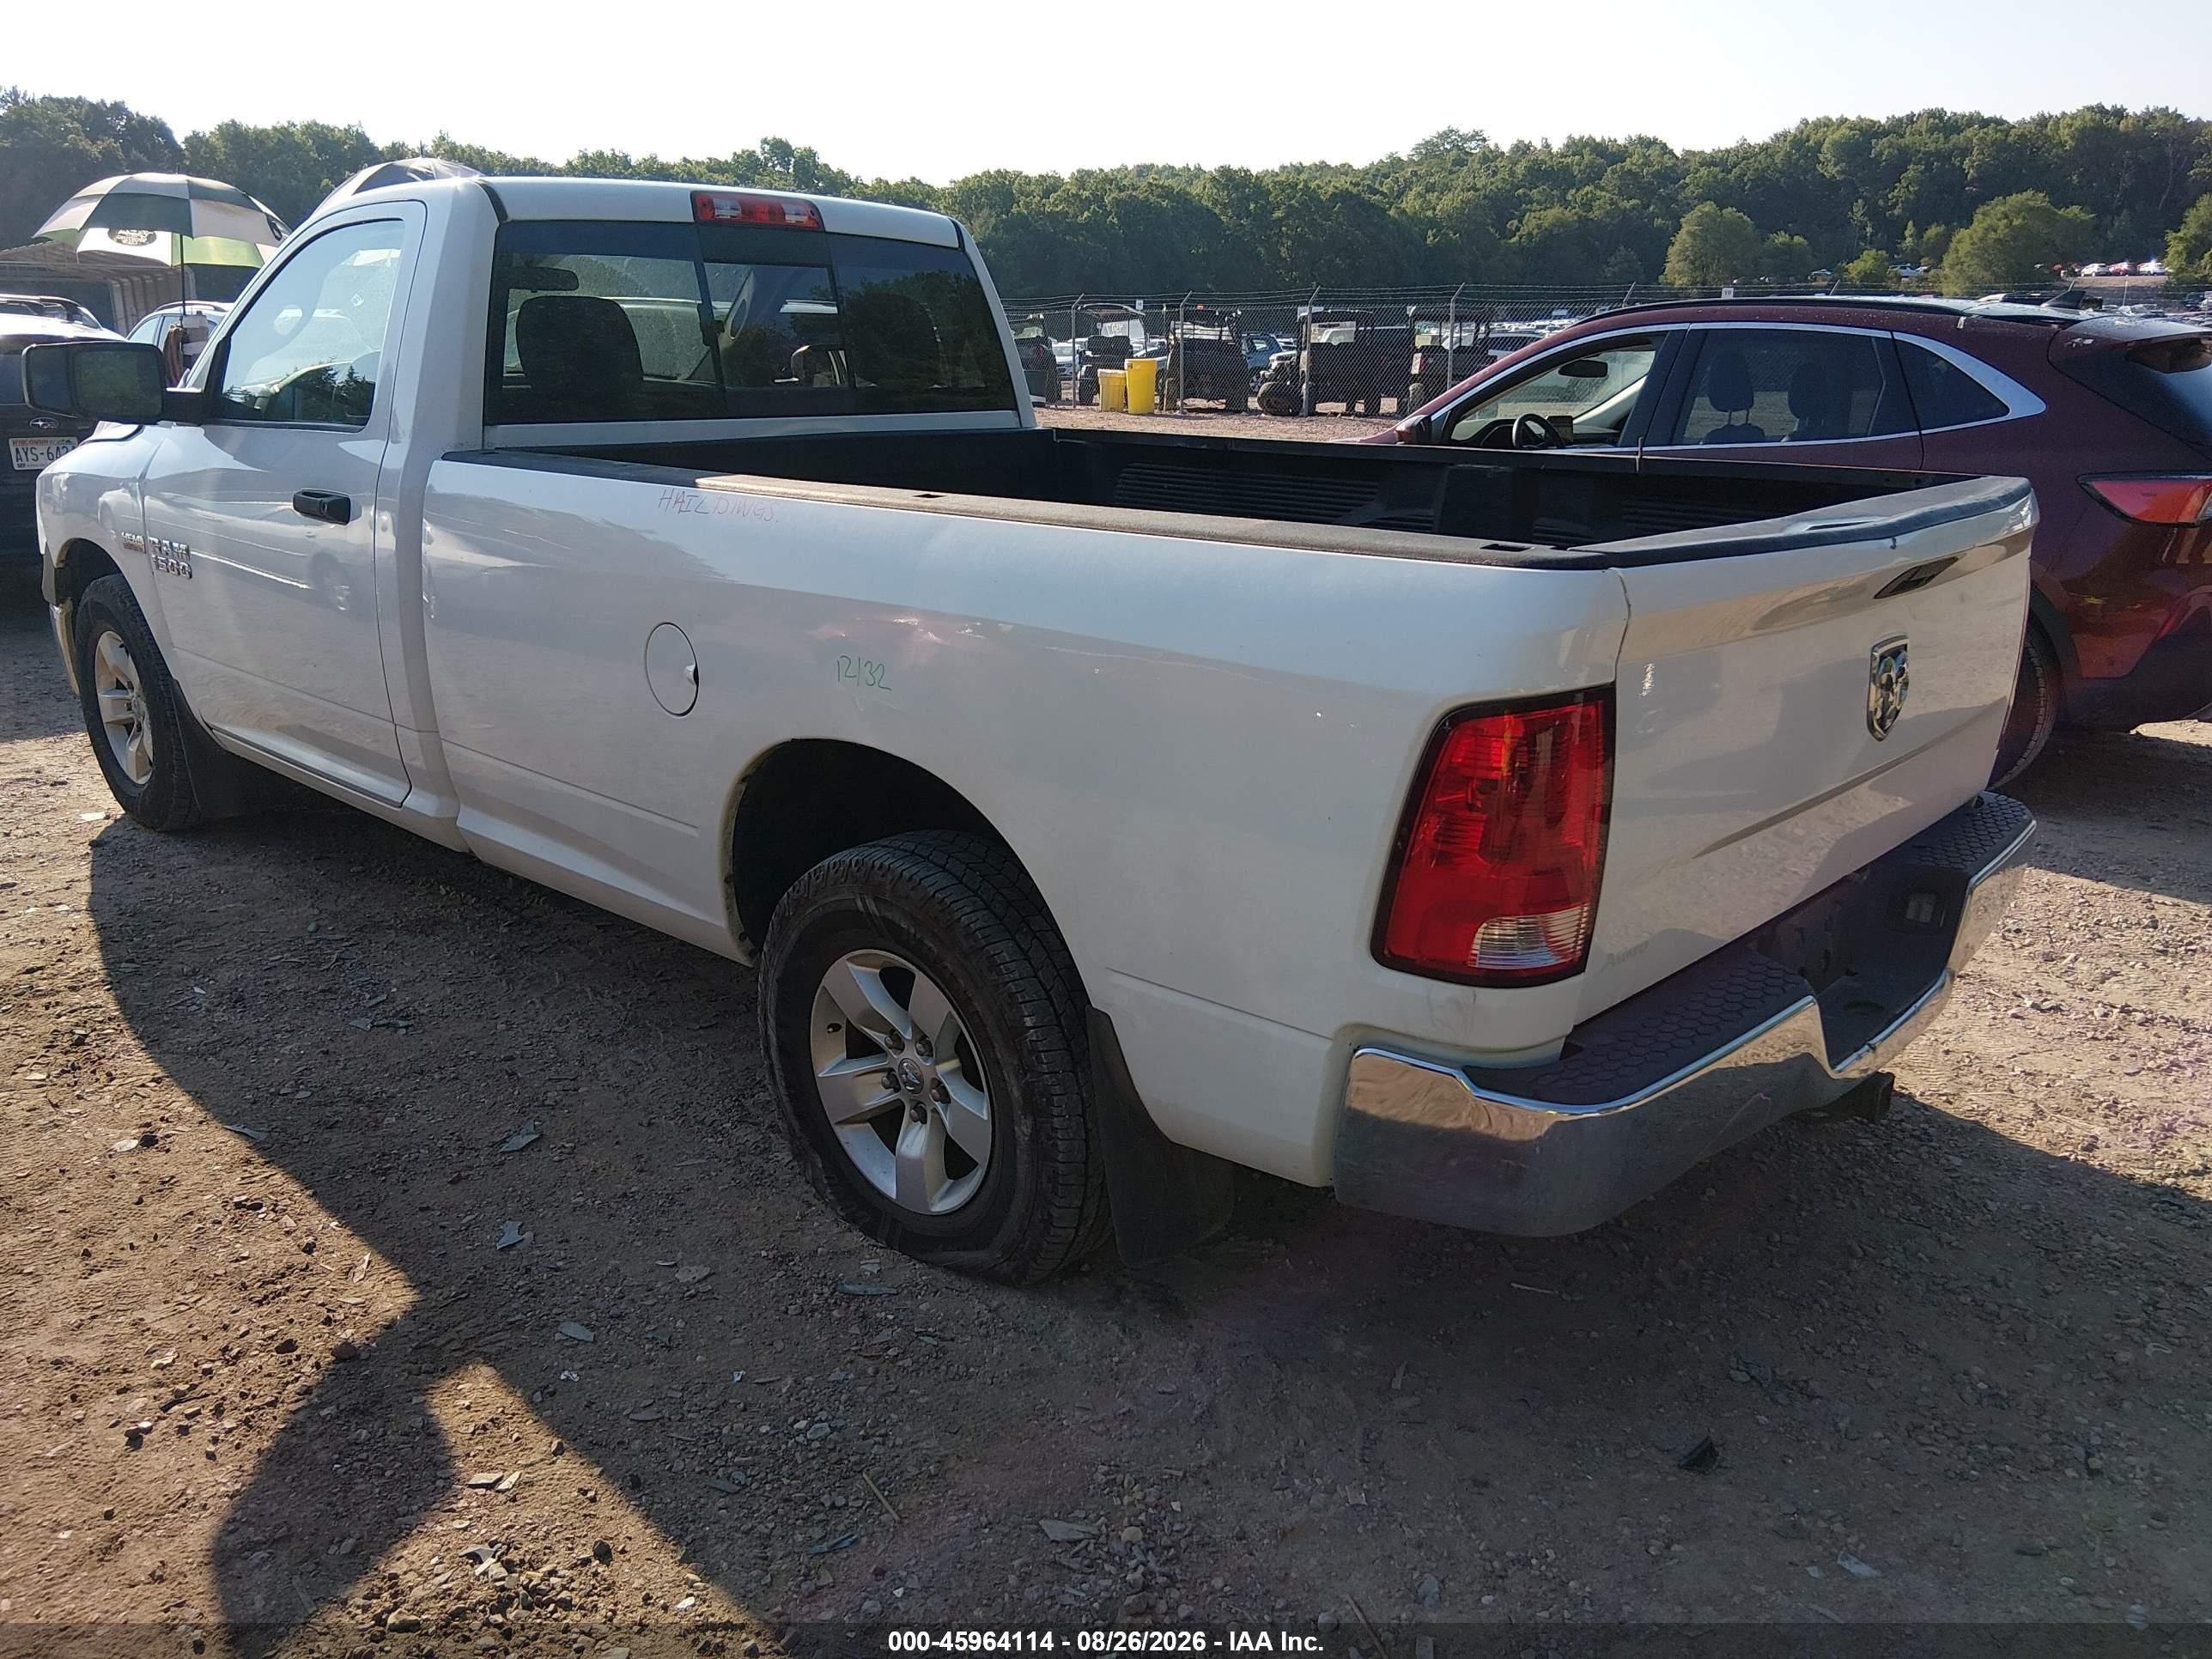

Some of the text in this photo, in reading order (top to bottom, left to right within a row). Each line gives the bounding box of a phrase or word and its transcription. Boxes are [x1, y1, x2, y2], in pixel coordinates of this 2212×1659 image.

[658, 487, 708, 514] HAIL
[148, 536, 191, 562] RAM
[151, 554, 192, 579] 1500
